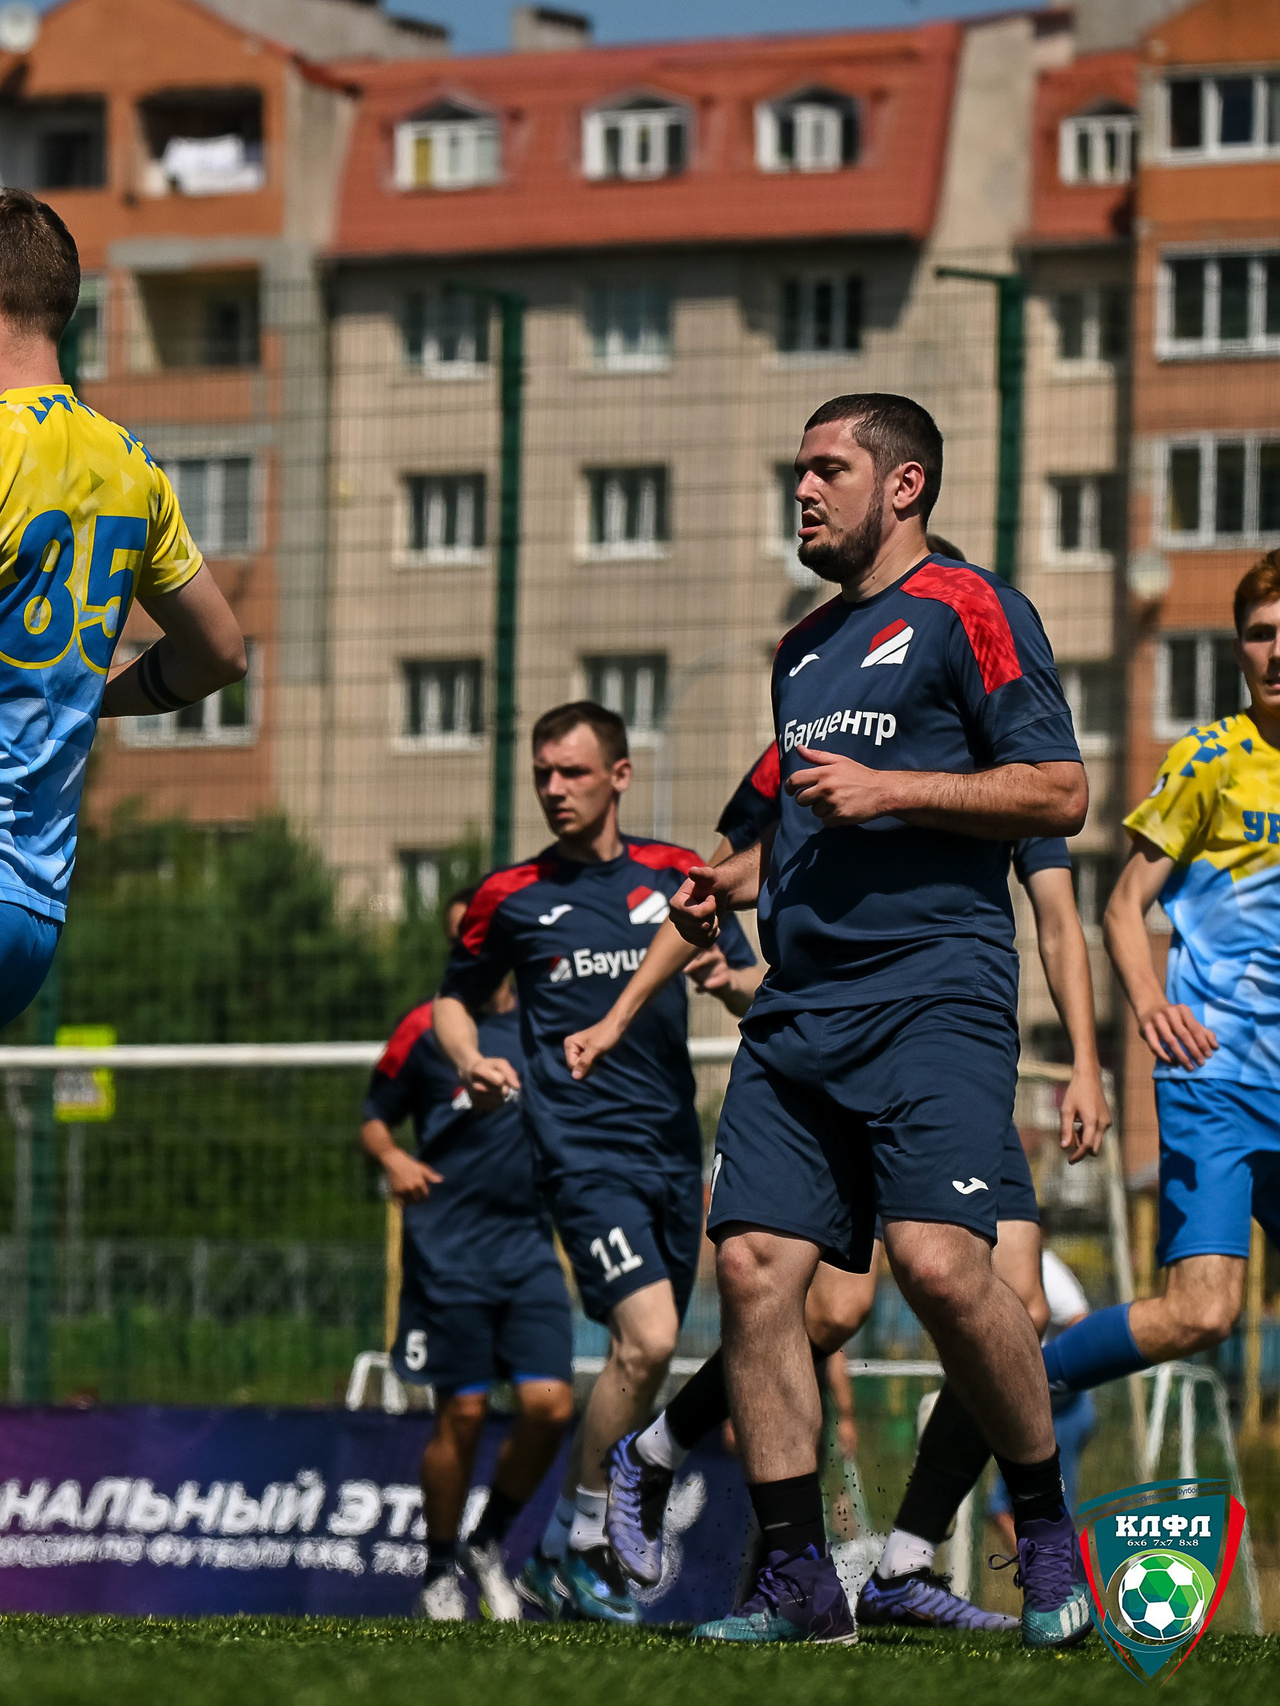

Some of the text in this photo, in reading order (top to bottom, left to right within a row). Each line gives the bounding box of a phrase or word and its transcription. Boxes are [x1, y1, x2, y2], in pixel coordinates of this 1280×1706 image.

[784, 709, 897, 753] Бауцентр
[590, 1227, 643, 1282] 11
[405, 1330, 428, 1371] 5
